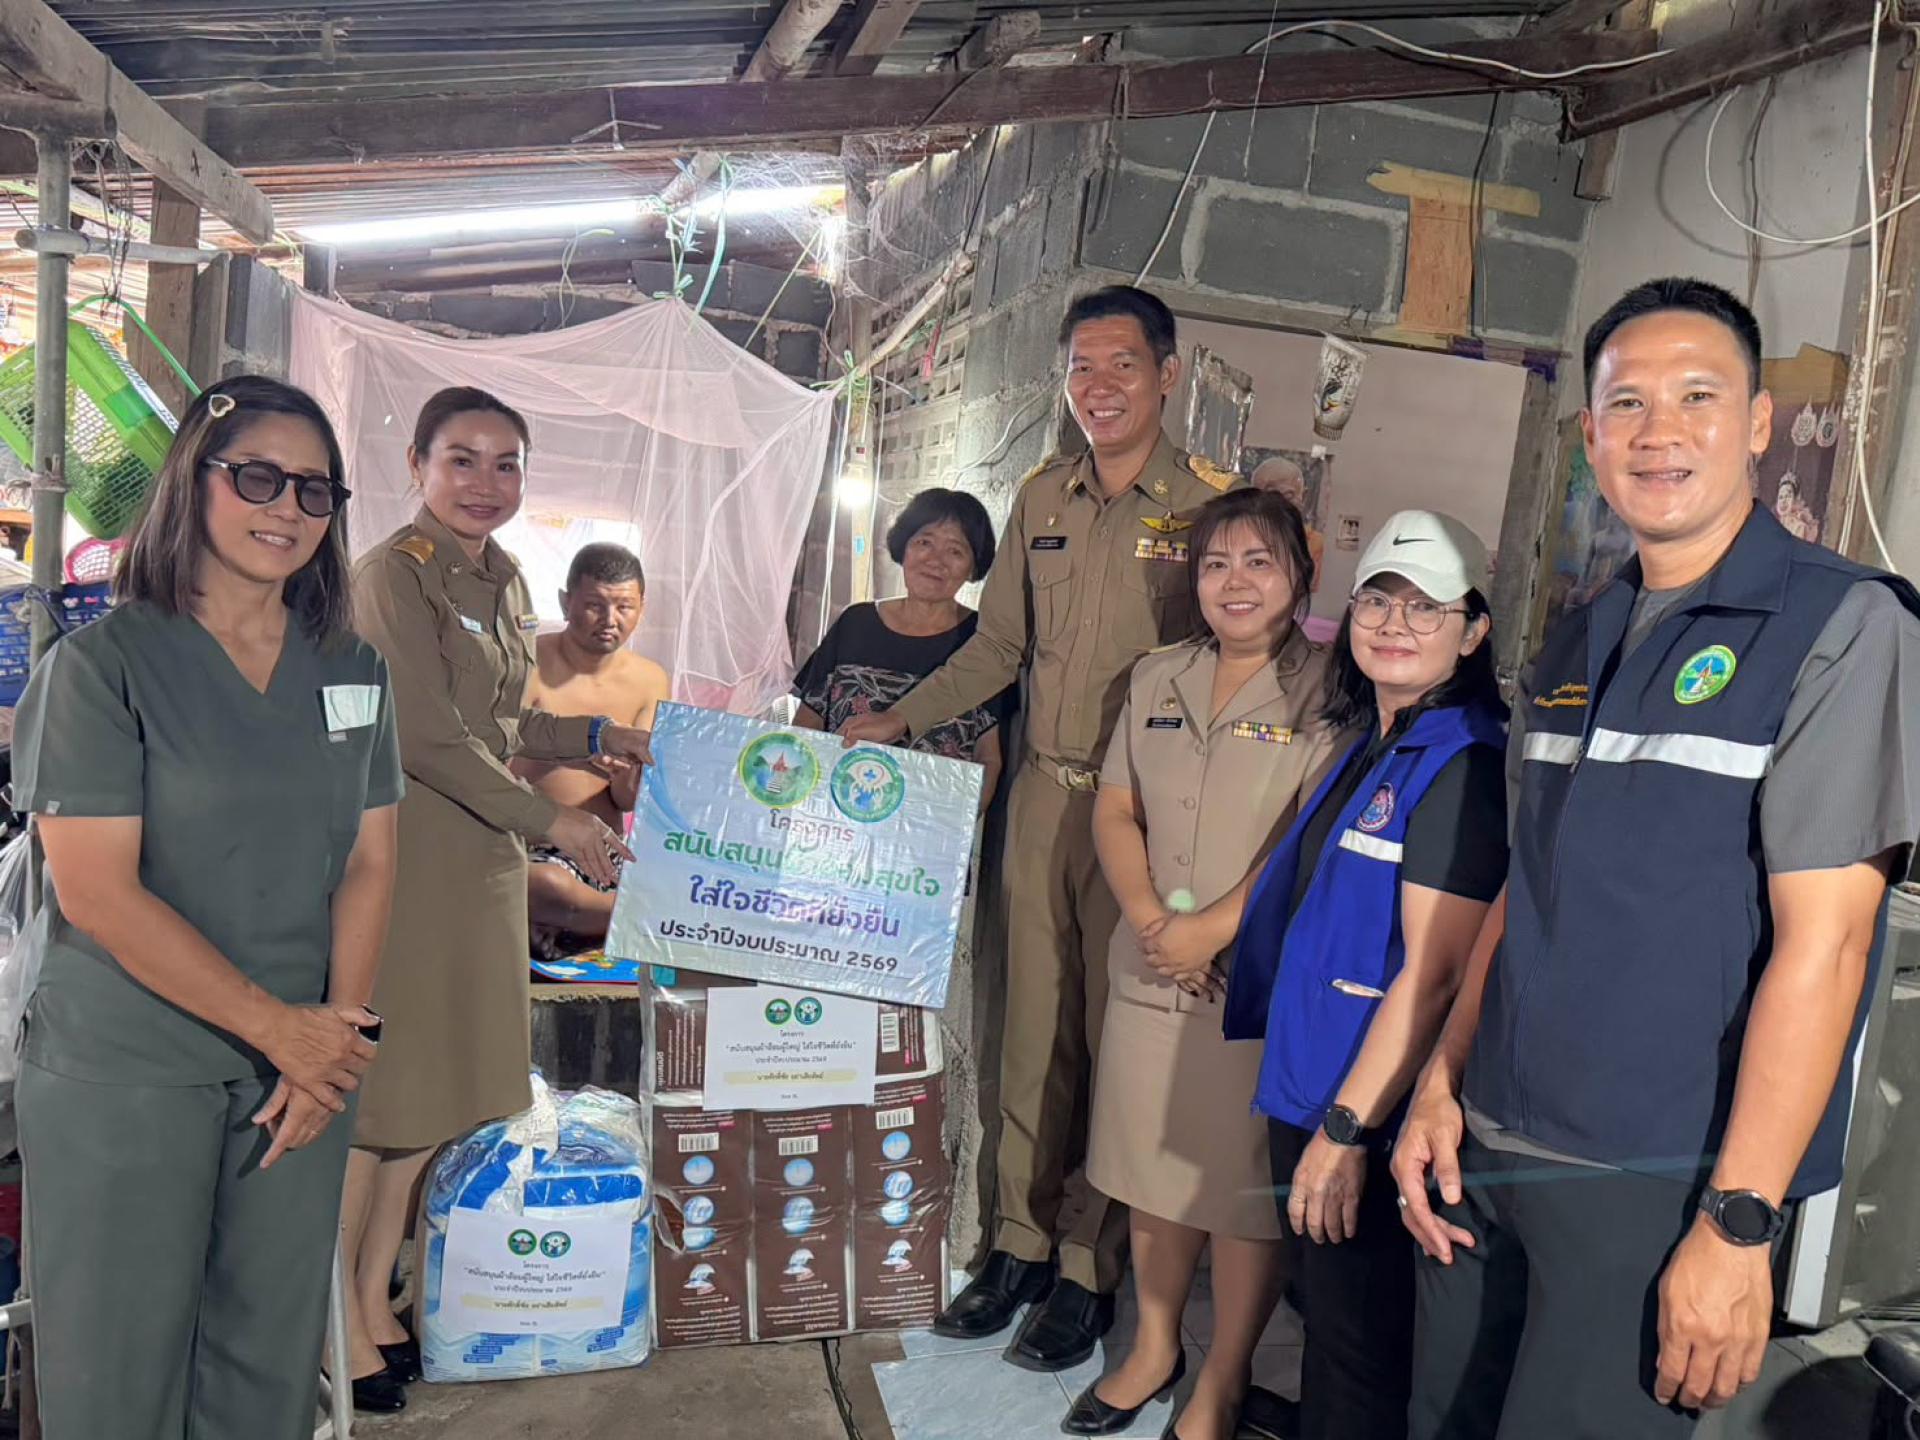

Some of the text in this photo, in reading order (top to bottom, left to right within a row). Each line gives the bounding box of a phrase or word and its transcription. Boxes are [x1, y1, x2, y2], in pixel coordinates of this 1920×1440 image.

[769, 808, 856, 843] โครงการ
[659, 919, 898, 972] ประจำปีงบประมาณ 2569
